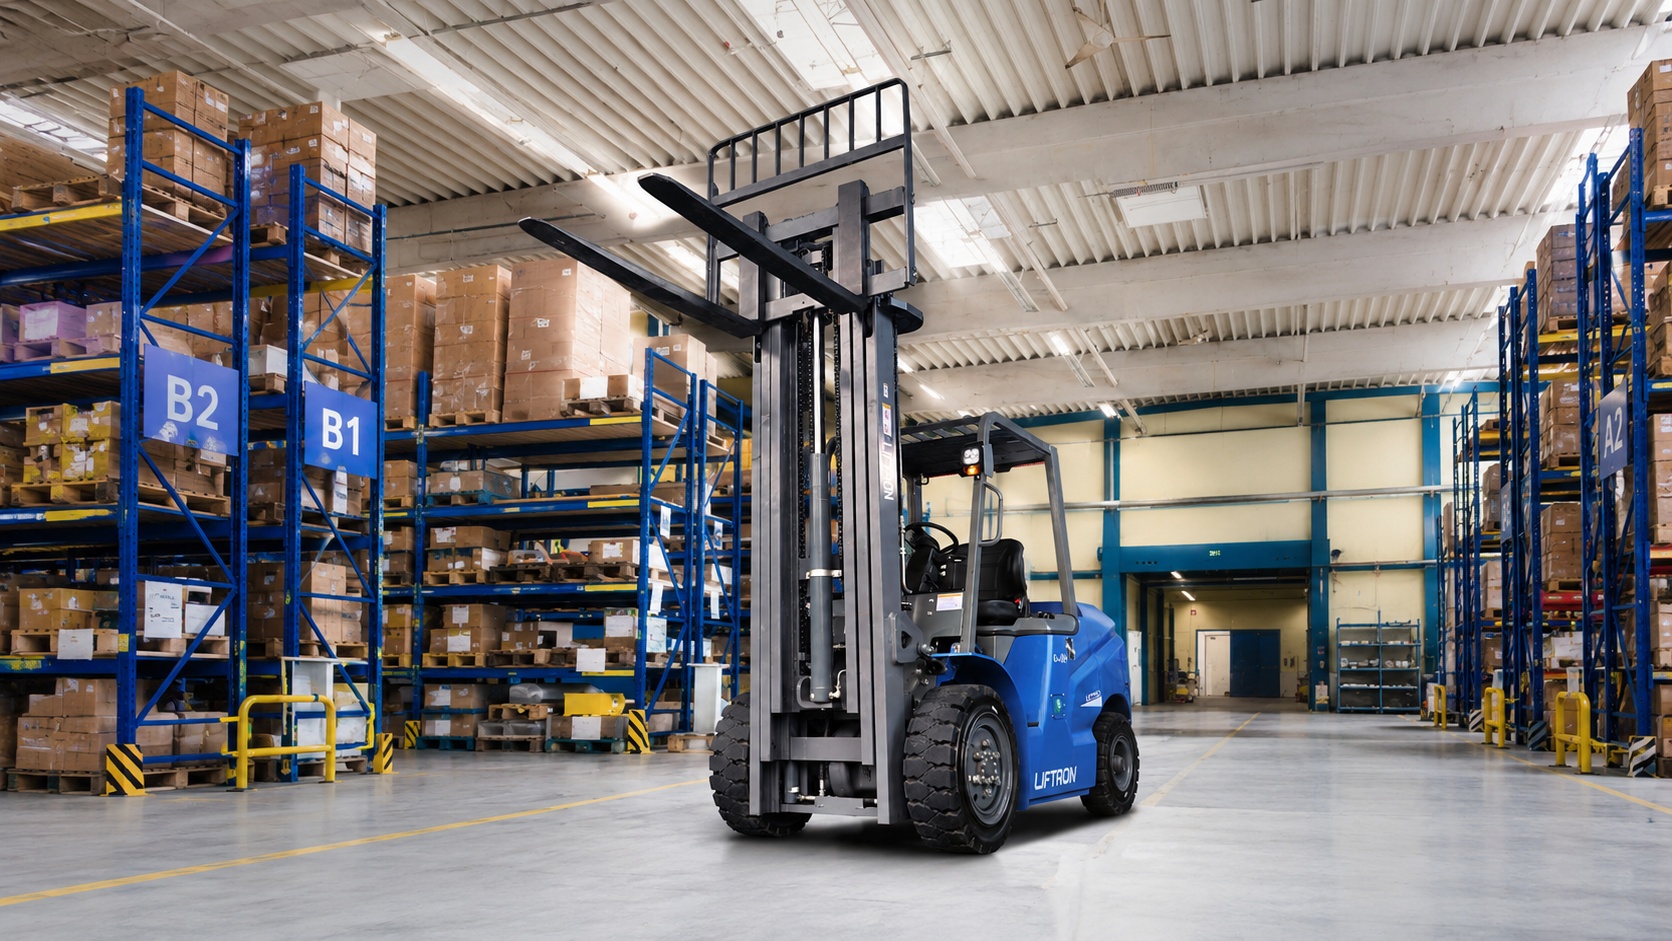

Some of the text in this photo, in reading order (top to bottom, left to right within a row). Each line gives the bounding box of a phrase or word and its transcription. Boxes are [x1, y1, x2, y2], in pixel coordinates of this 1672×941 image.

[167, 374, 219, 431] B2
[322, 407, 360, 456] B1
[1603, 406, 1623, 459] A2
[882, 441, 895, 500] LION
[1034, 765, 1078, 790] LIFTRON
